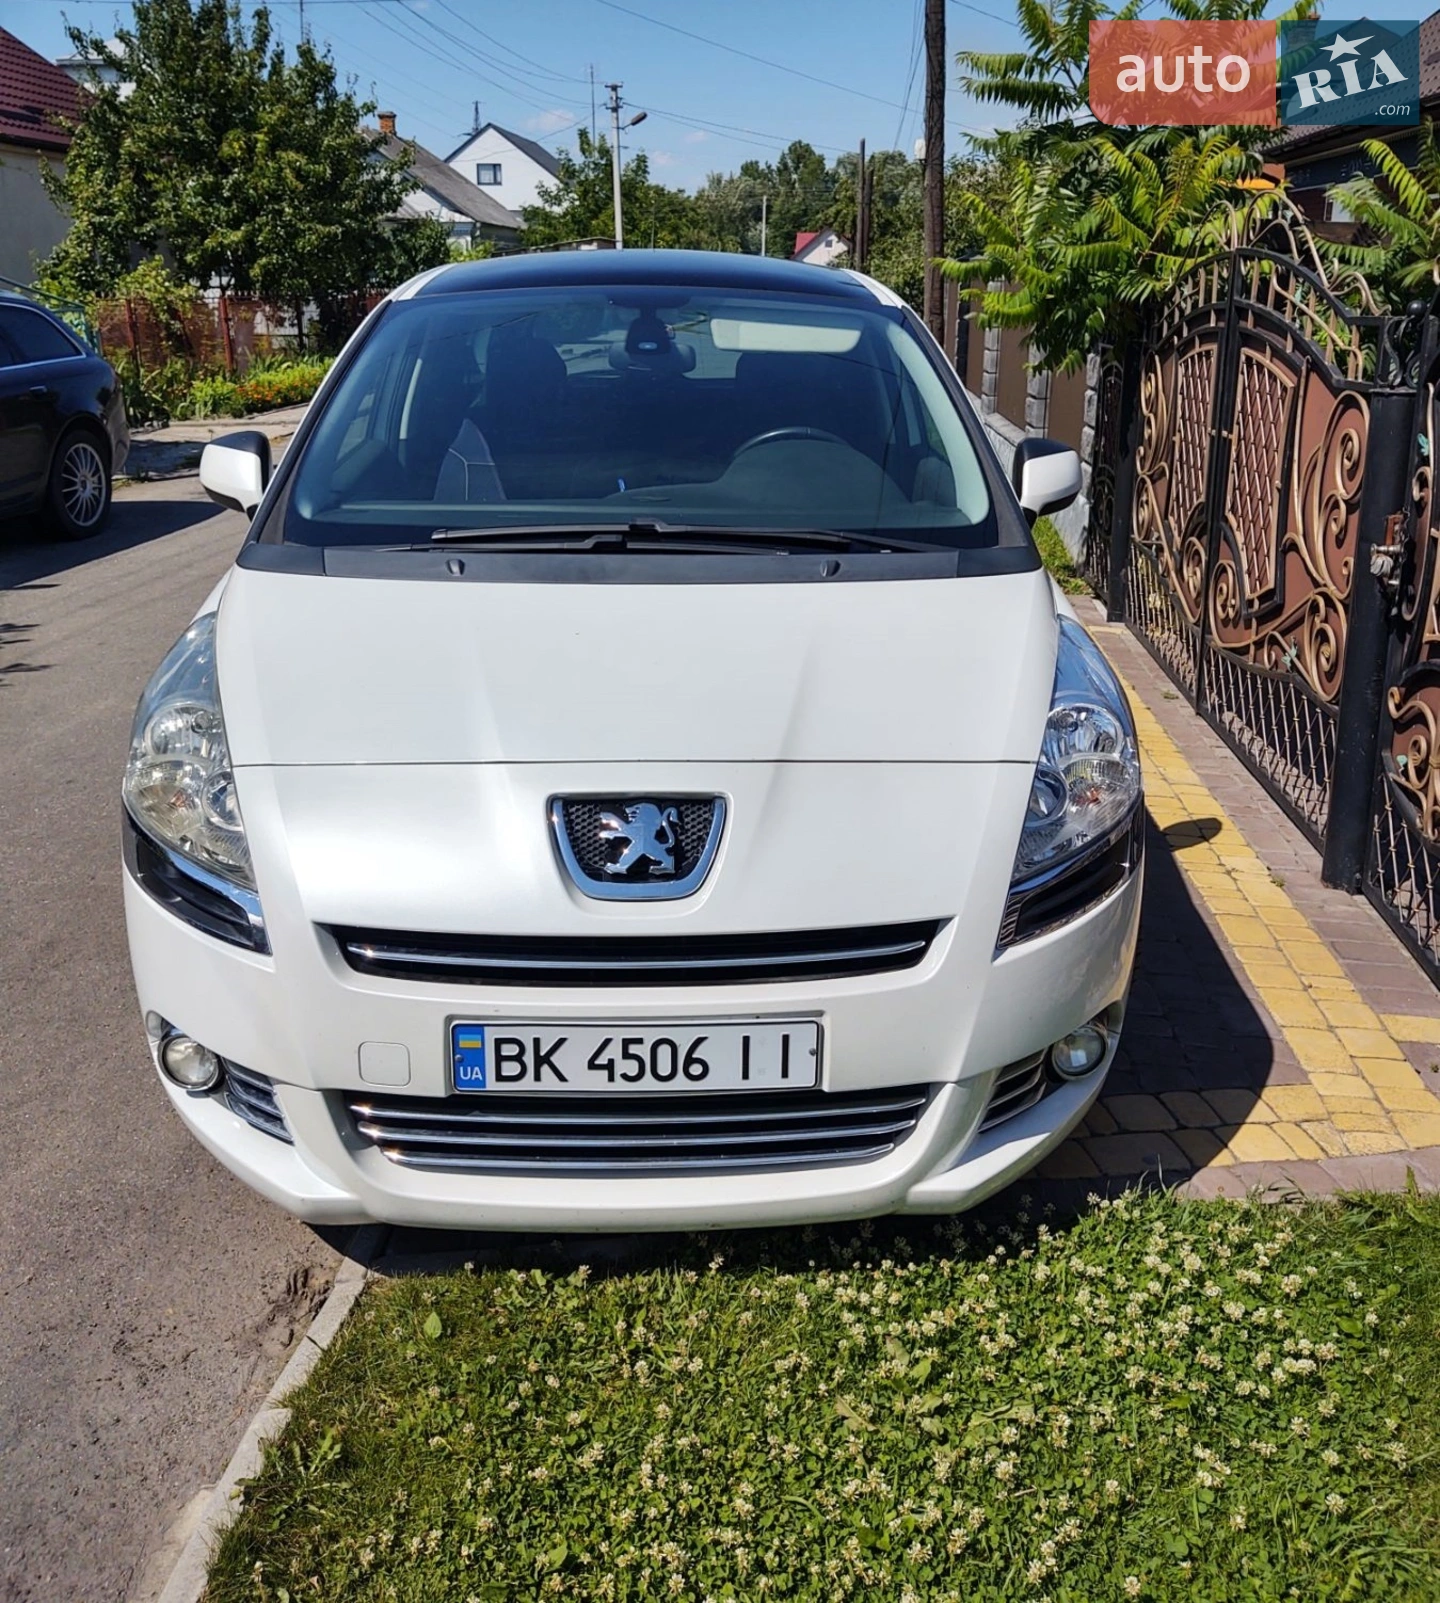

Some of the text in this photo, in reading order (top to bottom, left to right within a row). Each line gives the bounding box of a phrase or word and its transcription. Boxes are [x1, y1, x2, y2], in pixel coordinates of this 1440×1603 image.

[459, 1066, 483, 1081] UA
[493, 1036, 569, 1083] BK
[587, 1036, 710, 1083] 4506
